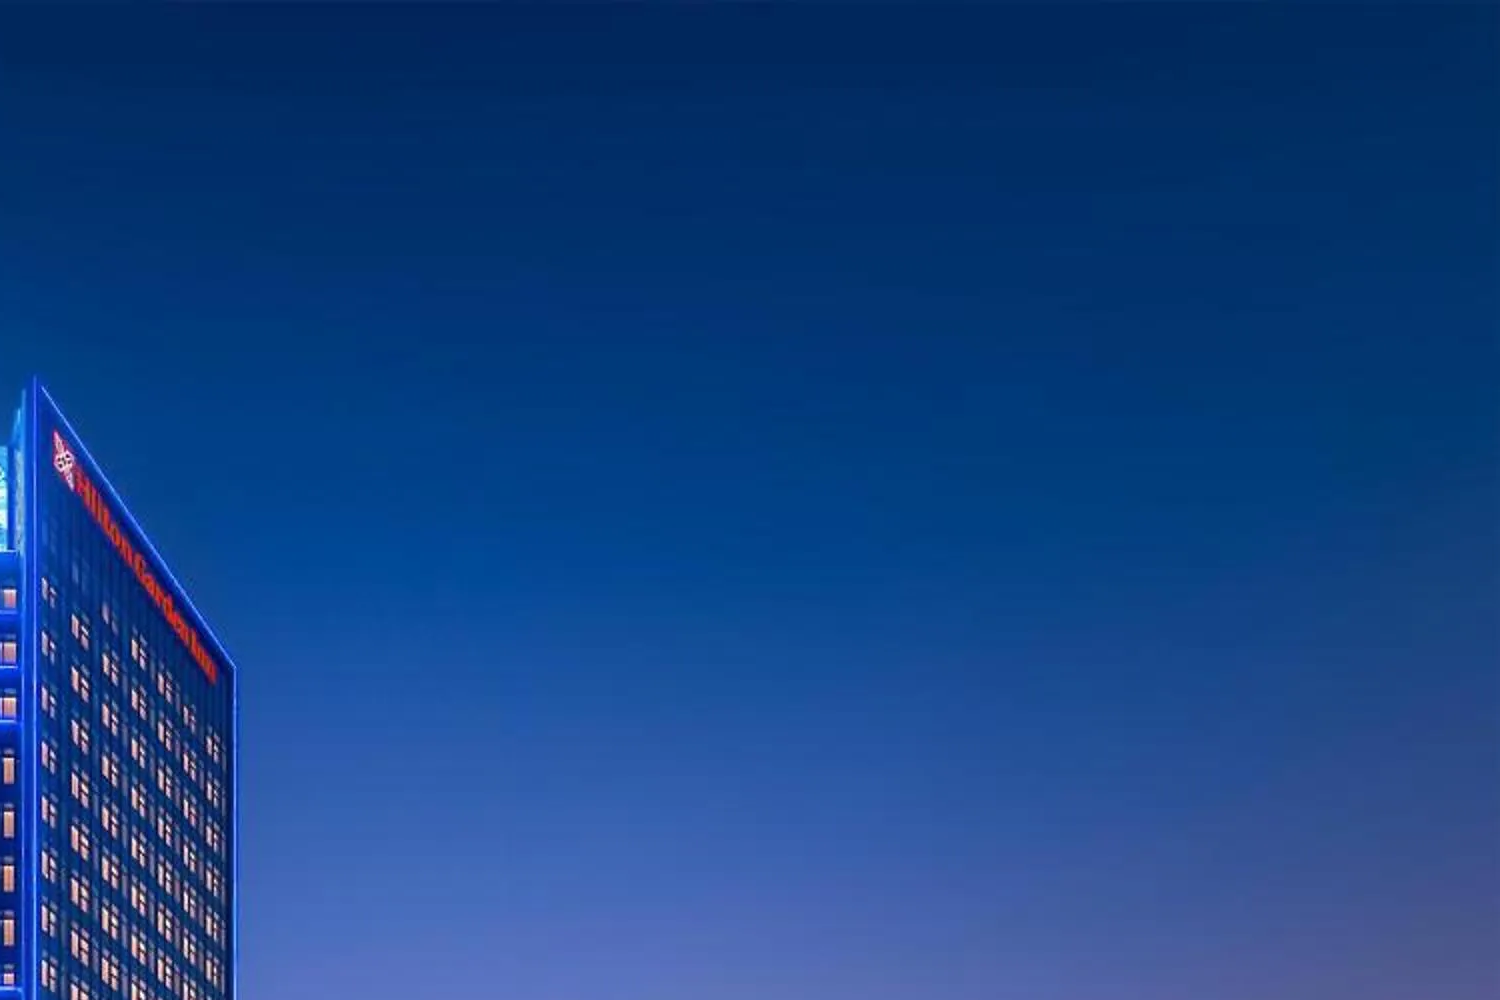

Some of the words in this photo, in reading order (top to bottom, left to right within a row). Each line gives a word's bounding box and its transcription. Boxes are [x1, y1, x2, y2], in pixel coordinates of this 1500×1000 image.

[75, 466, 133, 567] Hilton
[133, 553, 190, 645] Garden
[190, 630, 217, 684] Inn
